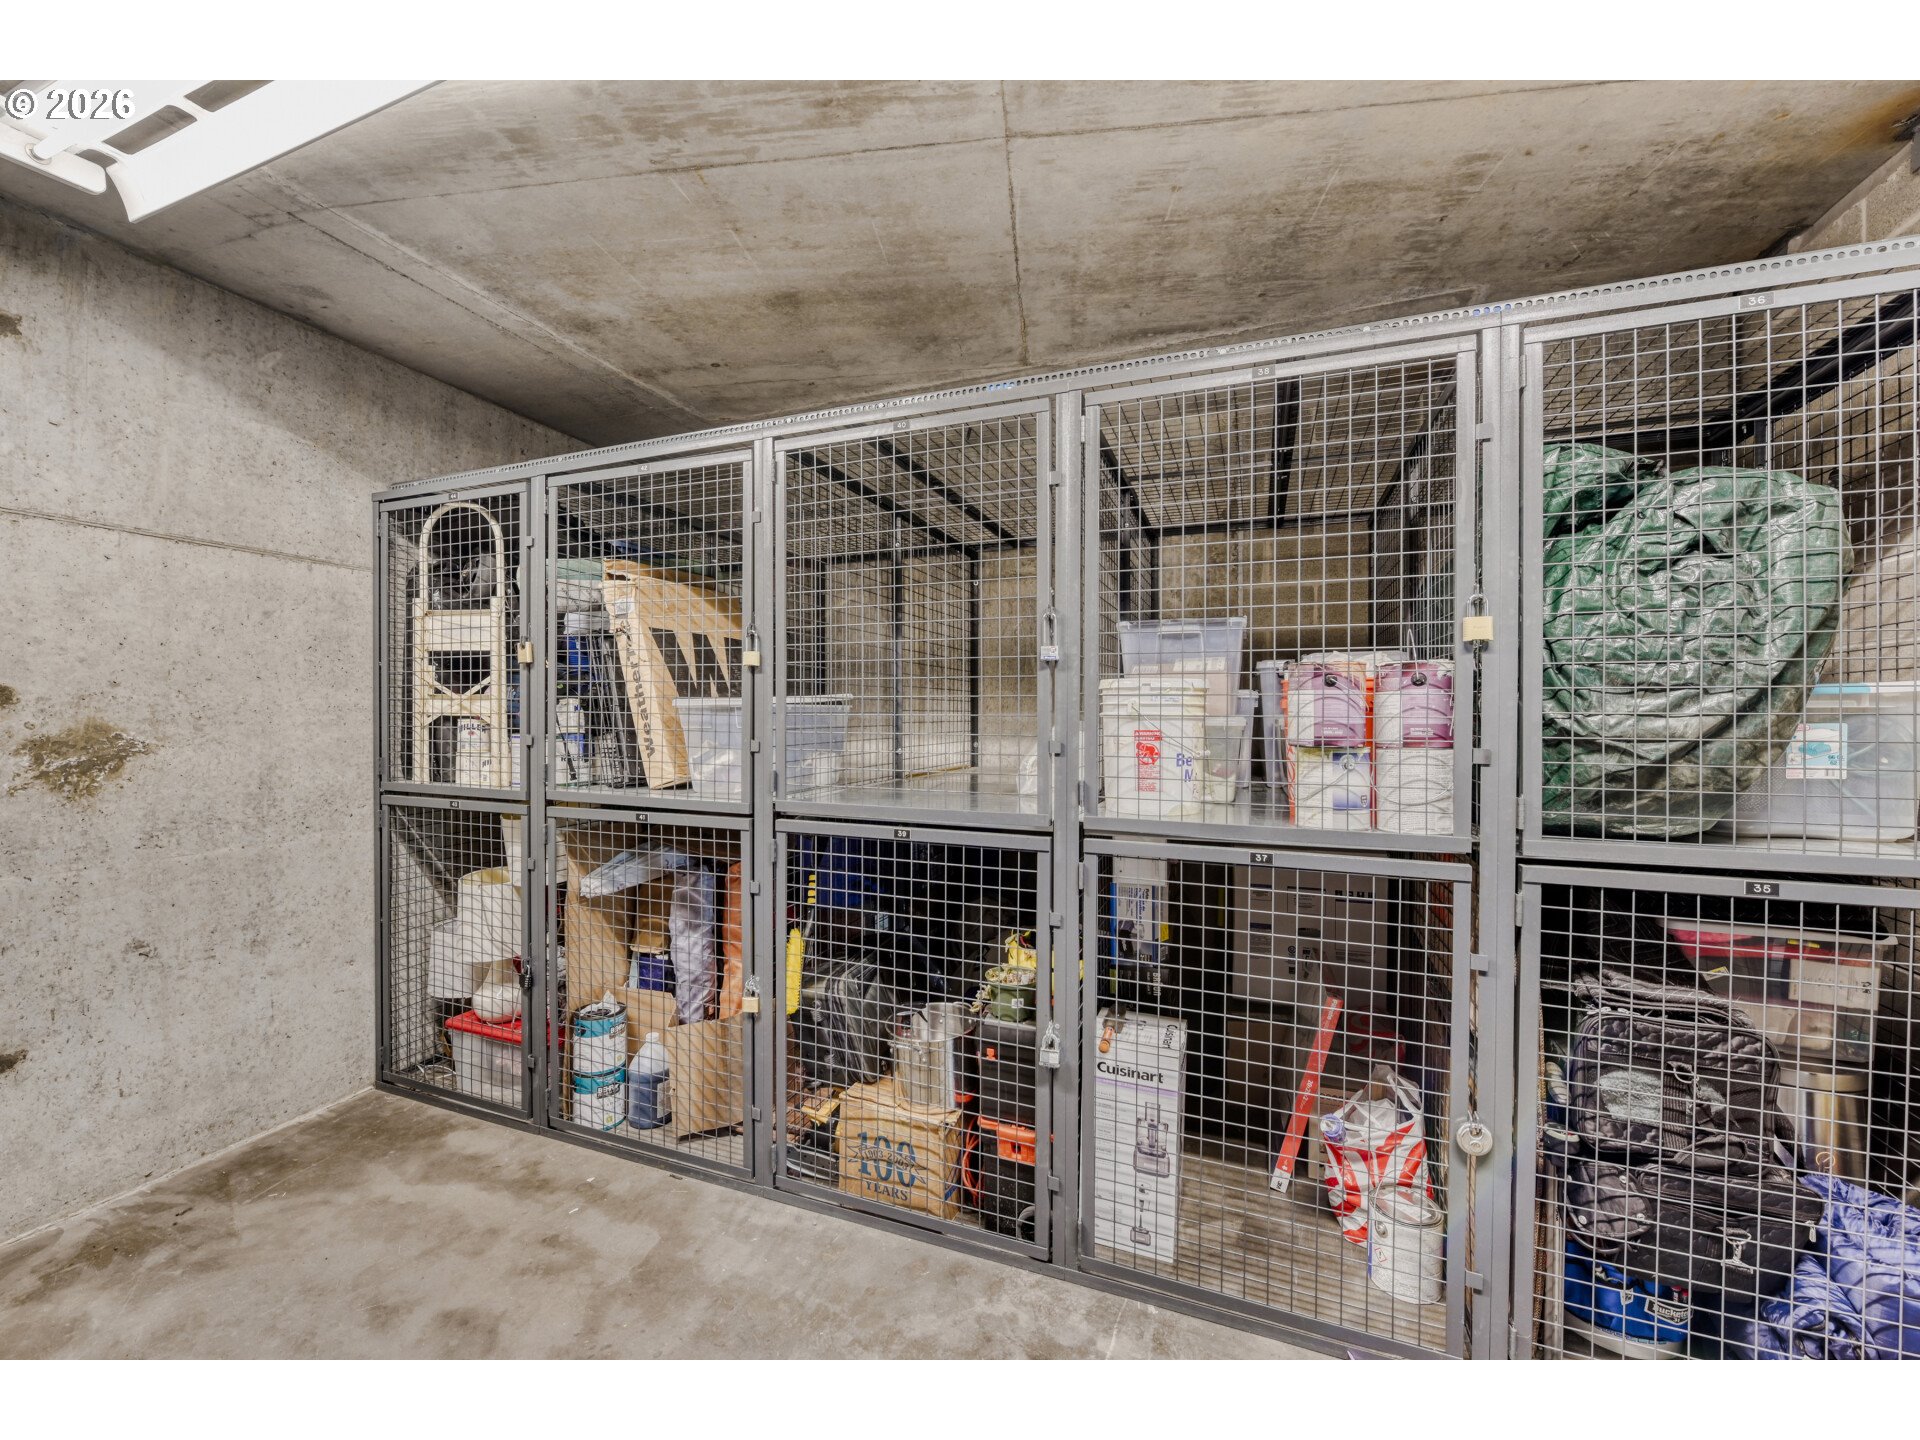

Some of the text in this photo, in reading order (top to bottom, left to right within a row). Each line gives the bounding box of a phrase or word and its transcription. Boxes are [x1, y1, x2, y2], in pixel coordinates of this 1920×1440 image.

[1748, 295, 1766, 306] 36
[1257, 367, 1270, 376] 38
[1255, 854, 1267, 862] 37
[1753, 884, 1771, 893] 35
[1096, 1061, 1164, 1084] Cuisinart
[857, 1131, 916, 1188] 100
[864, 1180, 909, 1201] YEARS
